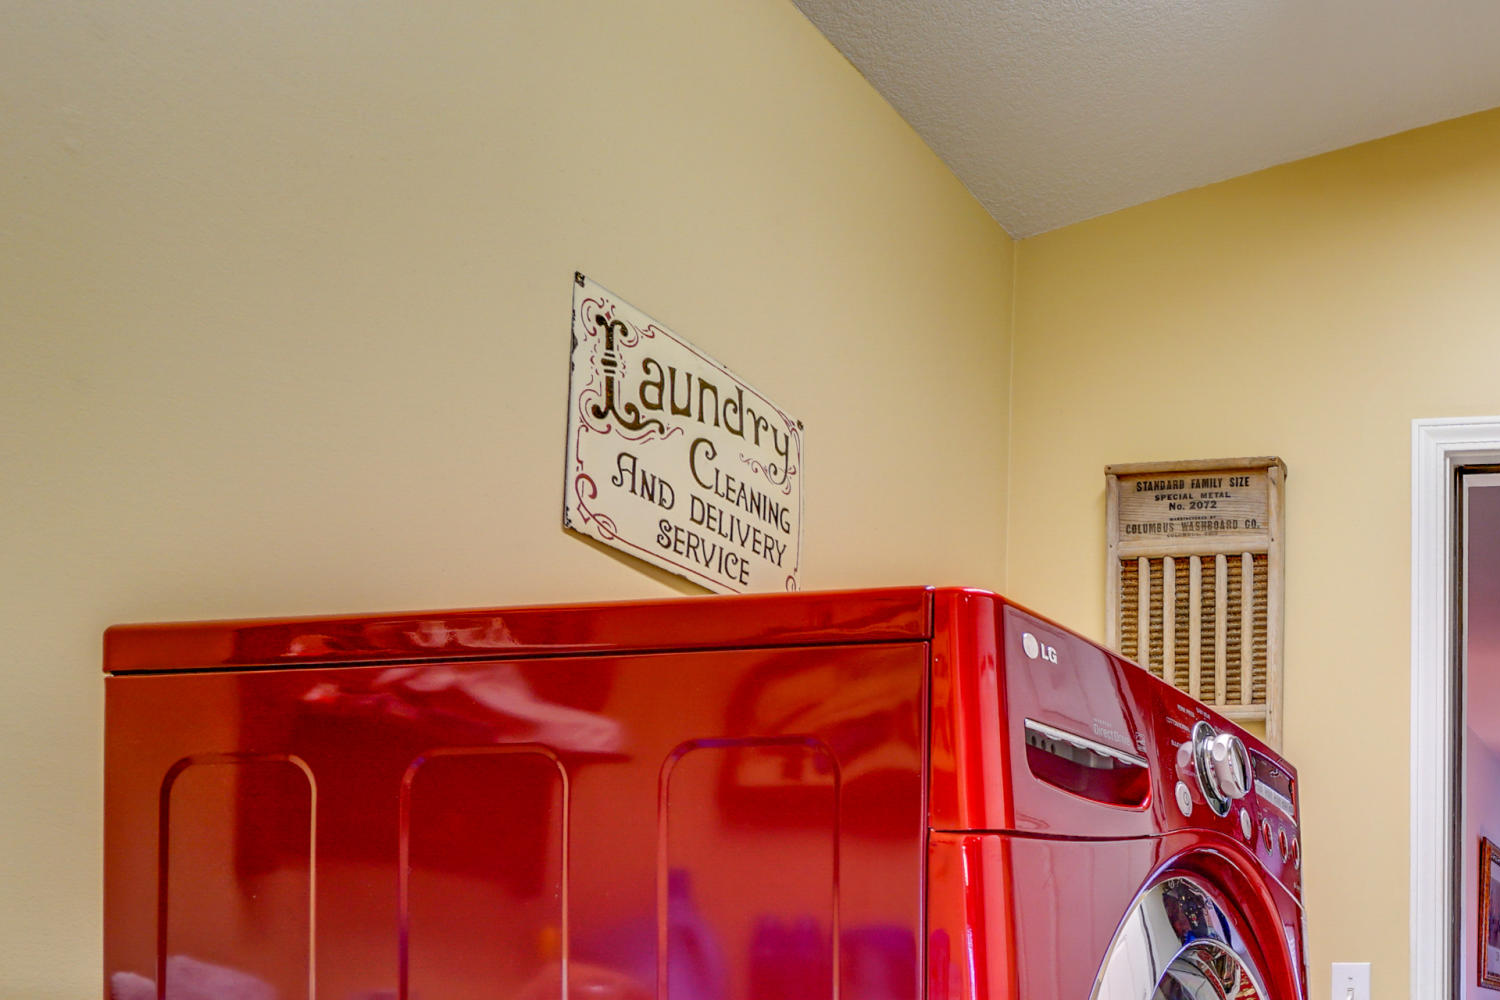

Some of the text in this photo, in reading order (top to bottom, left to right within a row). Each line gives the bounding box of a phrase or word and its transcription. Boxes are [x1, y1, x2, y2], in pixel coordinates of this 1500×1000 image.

[591, 313, 791, 486] Laundry
[689, 436, 792, 534] CLEANING
[1136, 476, 1250, 492] STANDARD FAMILY SIZE
[1154, 493, 1194, 501] SPECIAL
[1168, 501, 1217, 511] No. 2072
[611, 451, 787, 568] AND DELIVERY
[1125, 518, 1261, 534] COLUMBUS WASHBOARD CO.
[656, 518, 750, 586] SERVICE
[1040, 642, 1058, 664] LG
